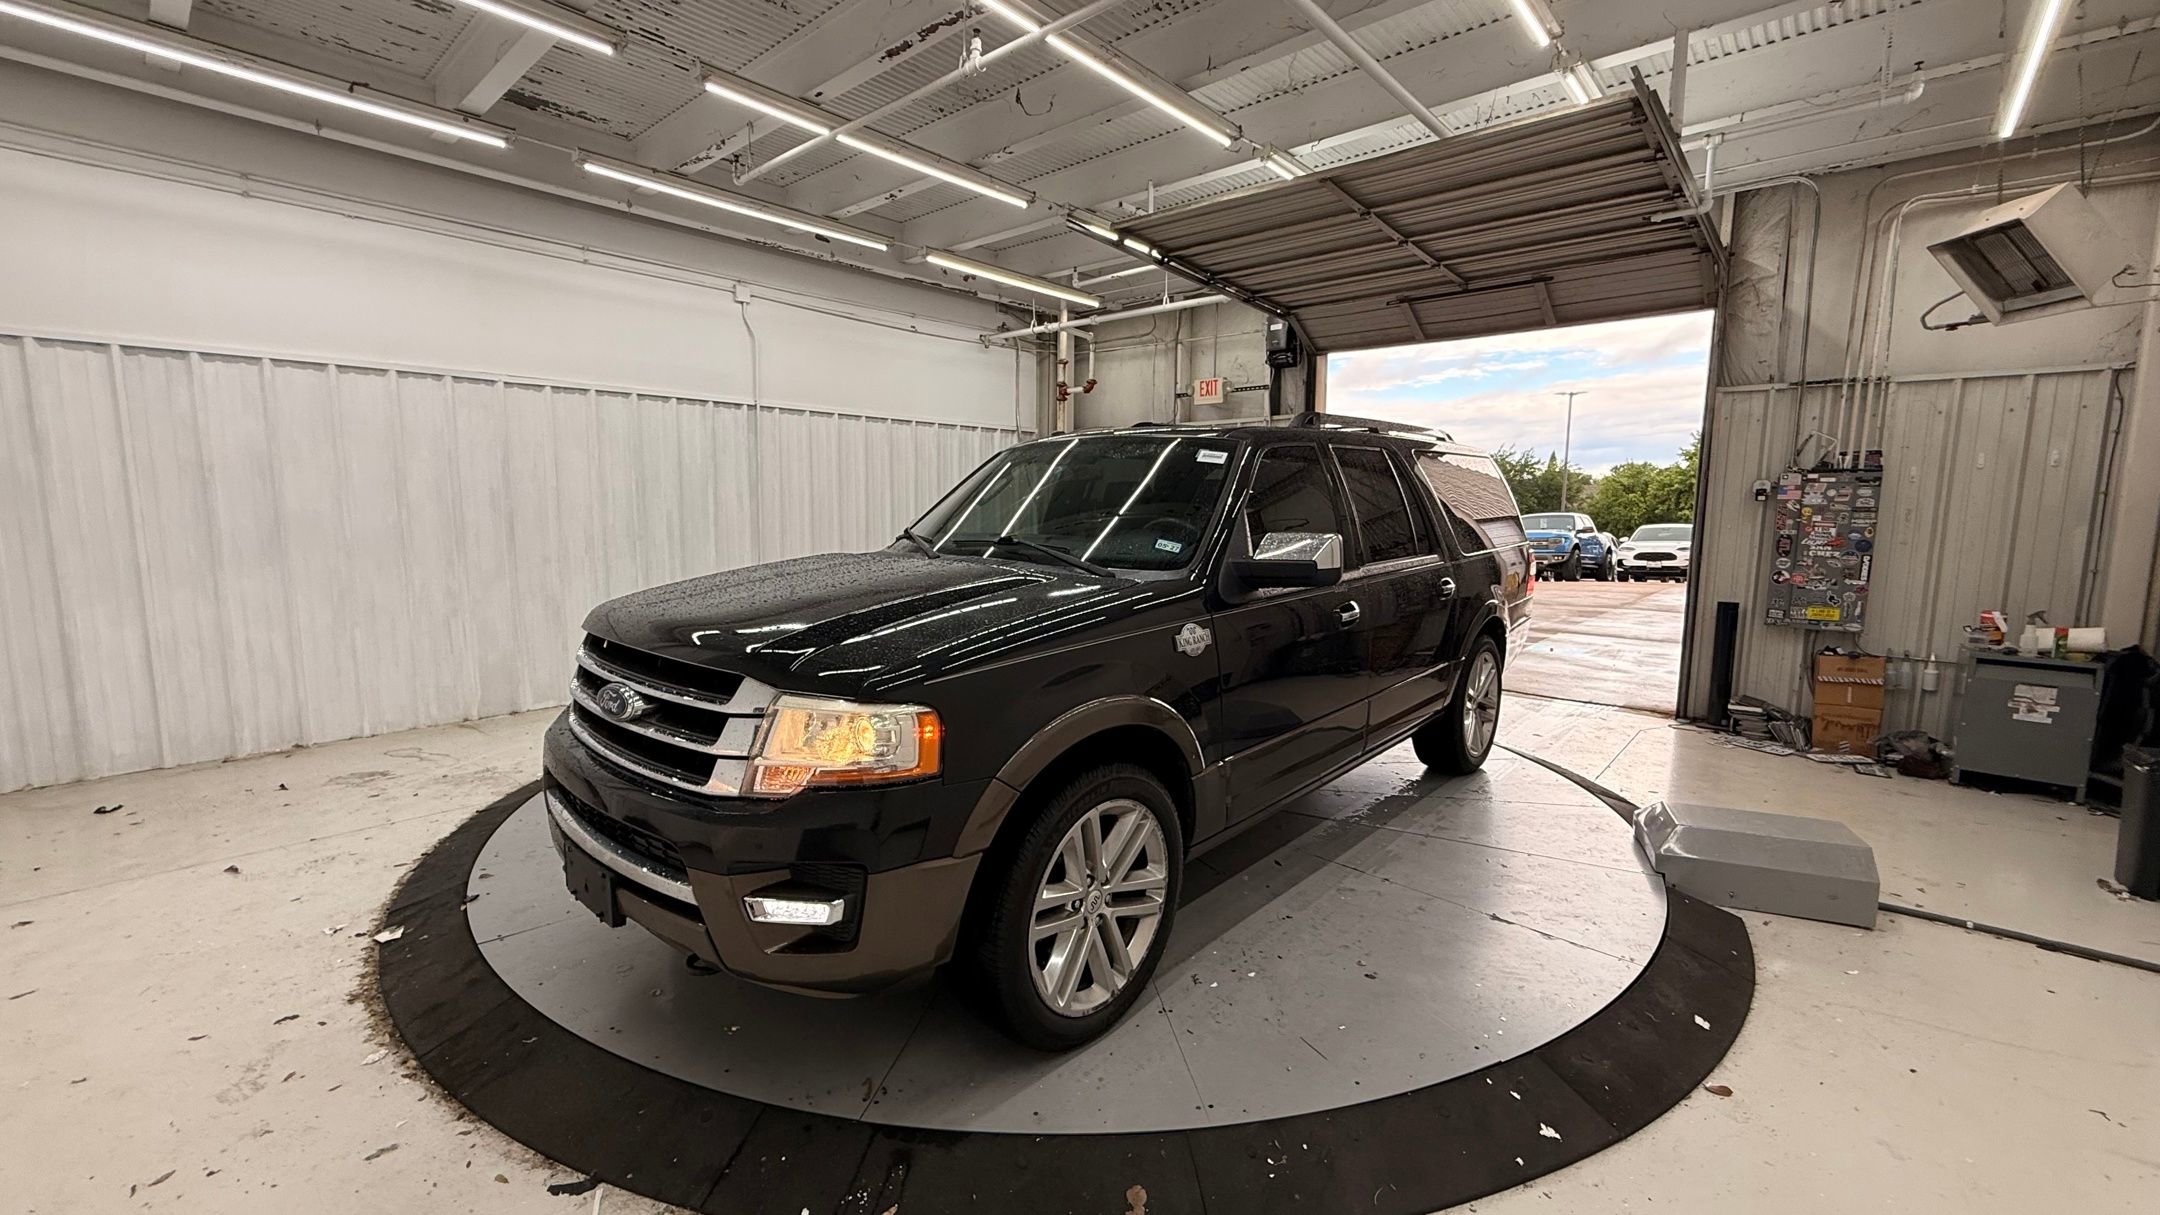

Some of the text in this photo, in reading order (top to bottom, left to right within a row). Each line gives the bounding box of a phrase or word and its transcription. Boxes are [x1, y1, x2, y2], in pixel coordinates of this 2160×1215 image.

[1199, 379, 1219, 397] EXIT
[1178, 631, 1210, 648] KING RANCH
[599, 689, 621, 713] Ford
